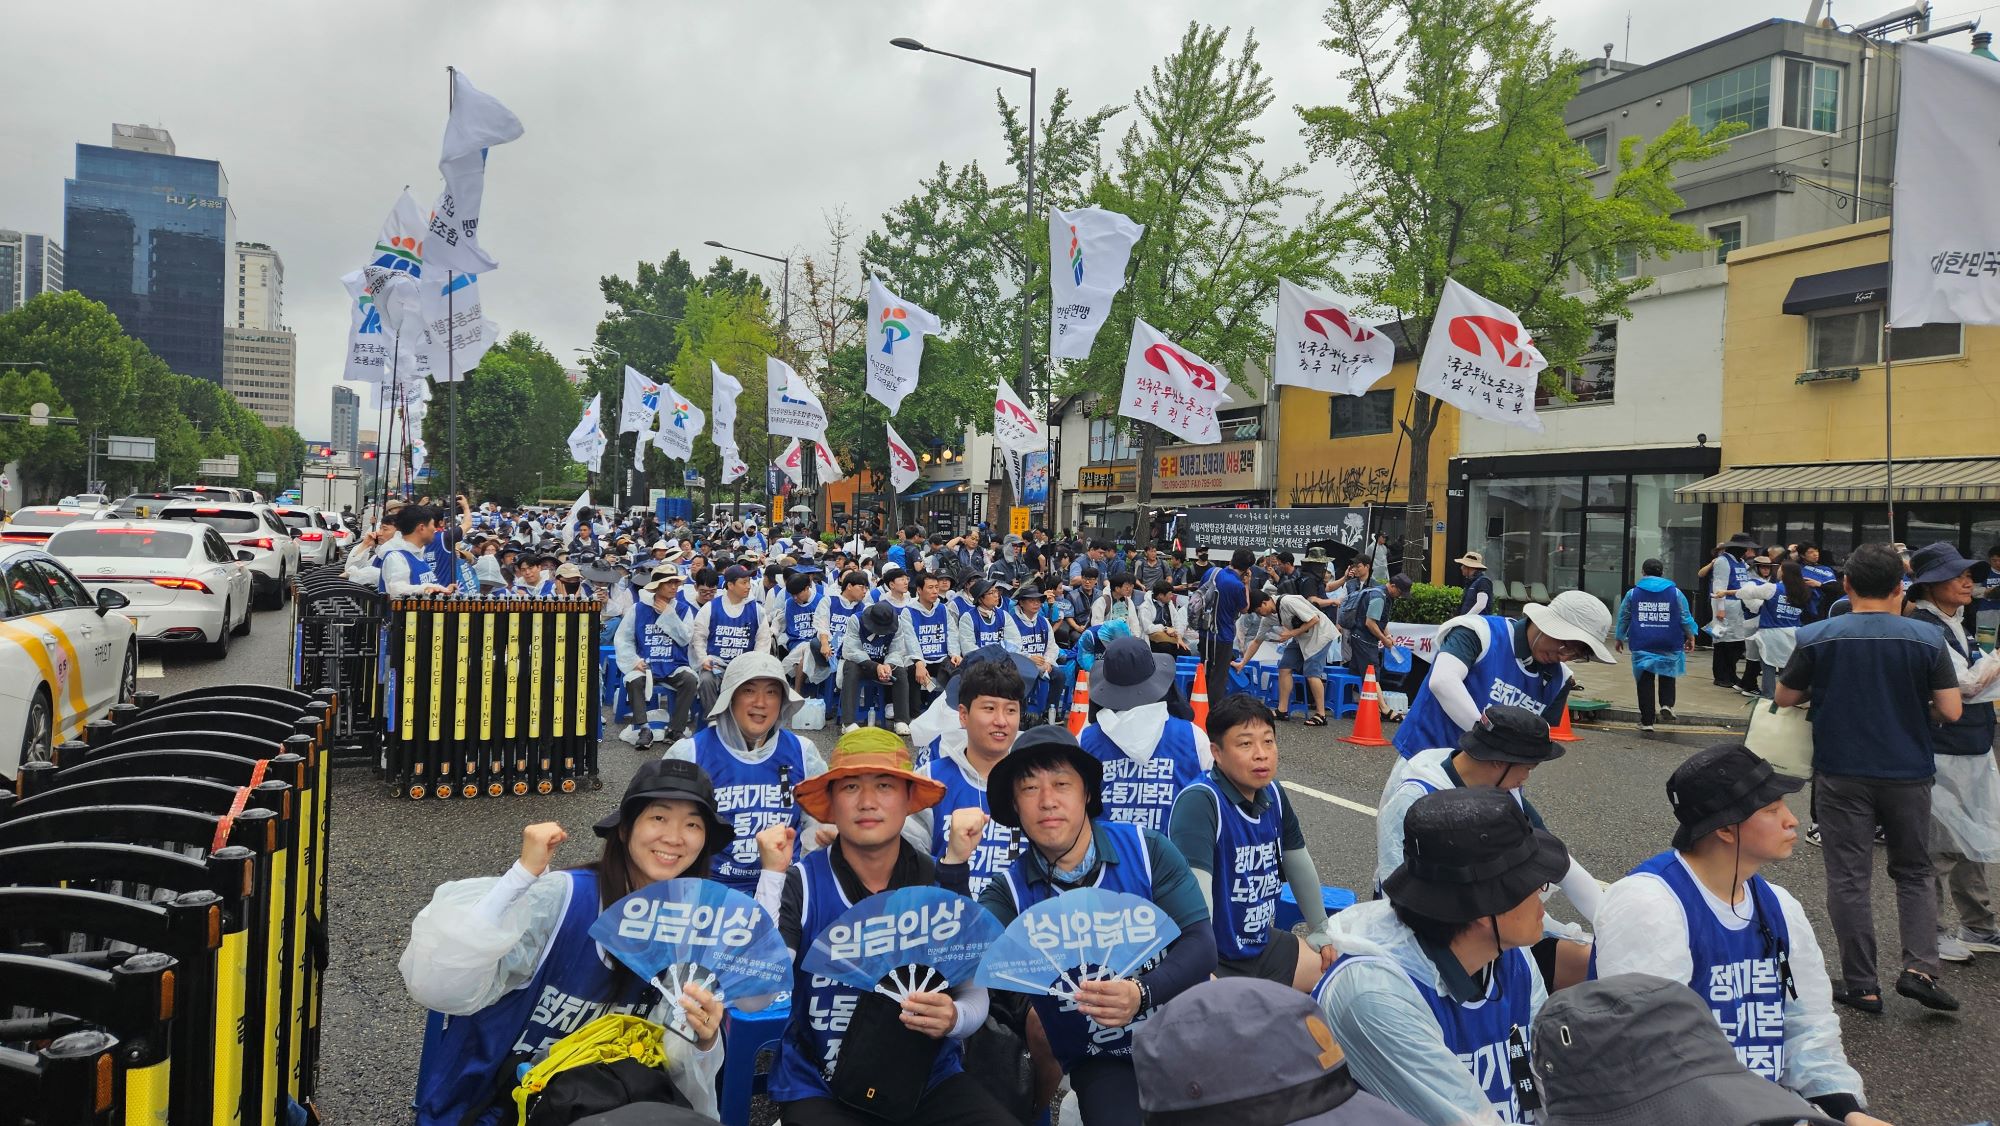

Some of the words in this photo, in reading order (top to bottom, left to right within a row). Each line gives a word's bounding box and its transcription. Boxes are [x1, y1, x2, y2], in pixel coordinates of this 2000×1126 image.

[1930, 250, 2000, 278] 대한민국
[973, 494, 981, 525] COFFEE
[714, 637, 750, 648] 노동기본권
[433, 636, 442, 686] POLICE
[484, 636, 492, 685] POLICE
[532, 636, 540, 684] POLICE
[431, 695, 439, 728] LINE
[1101, 758, 1175, 783] 정치기본권
[714, 783, 797, 813] 정치기본
[1101, 783, 1175, 805] 노동기본권
[618, 897, 762, 947] 임금인상
[828, 898, 965, 961] 임금인상
